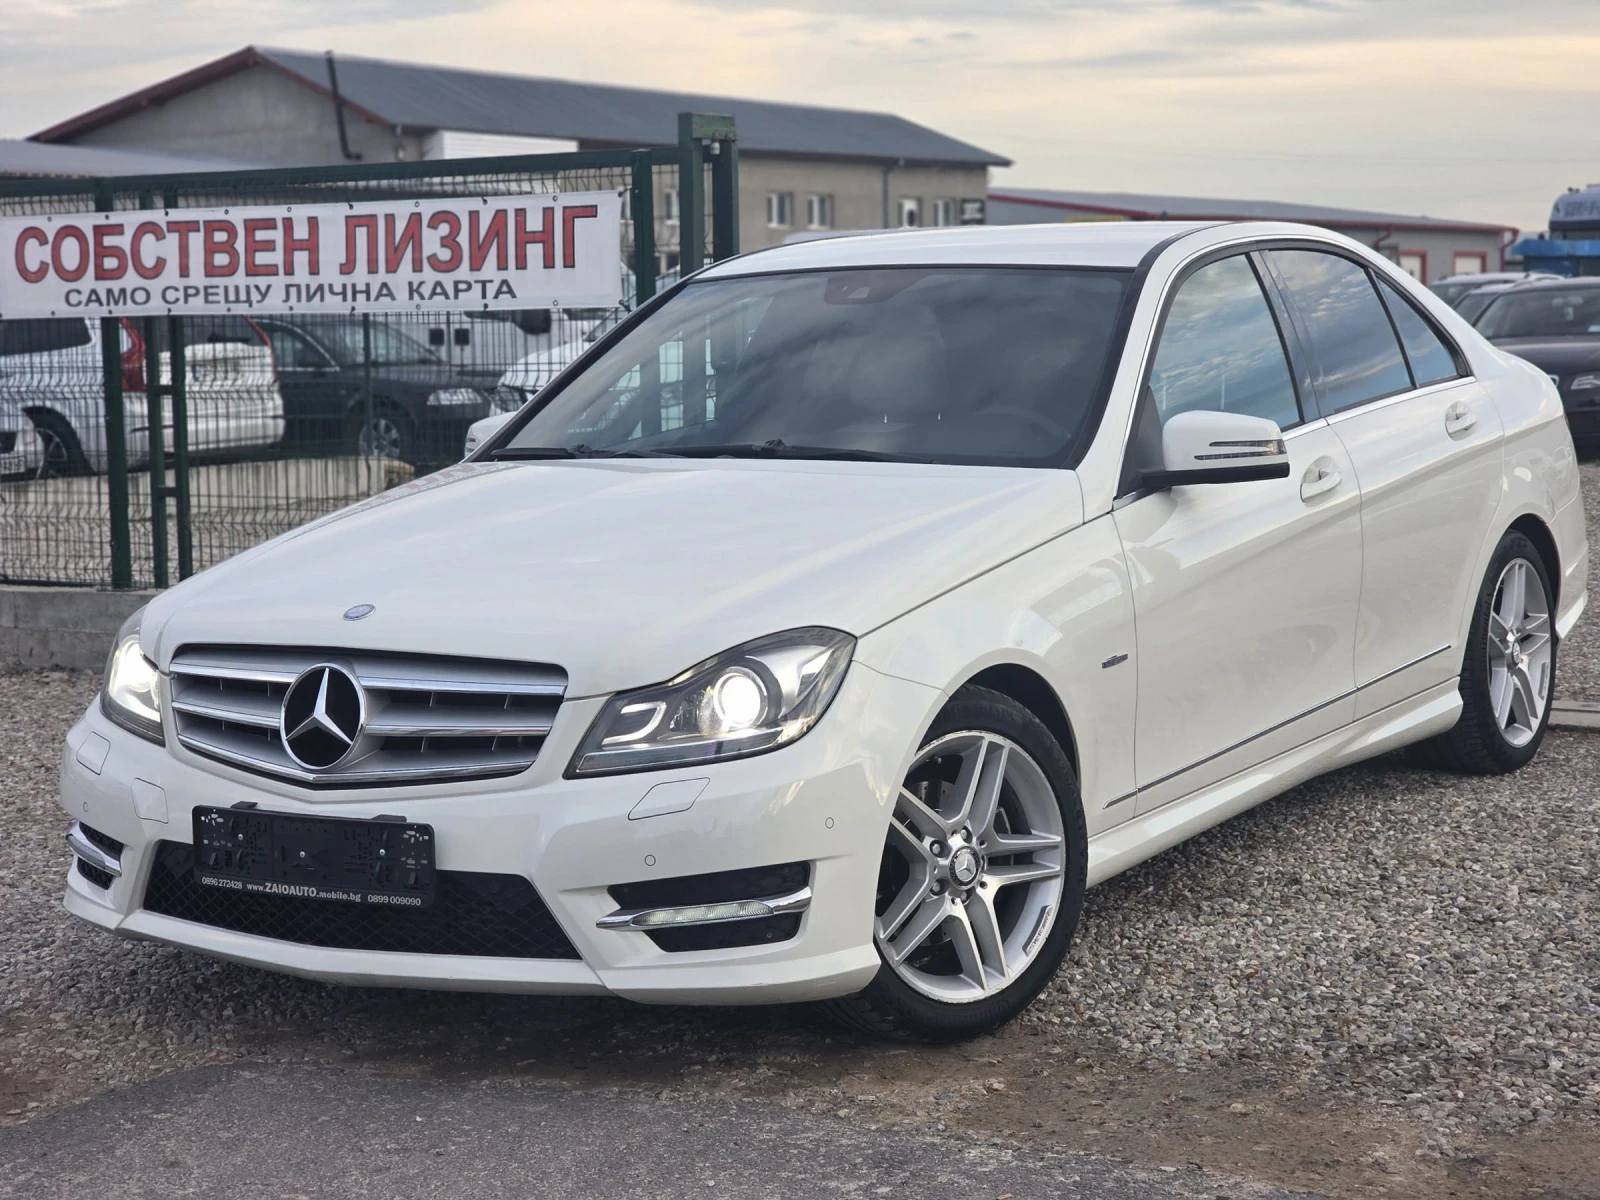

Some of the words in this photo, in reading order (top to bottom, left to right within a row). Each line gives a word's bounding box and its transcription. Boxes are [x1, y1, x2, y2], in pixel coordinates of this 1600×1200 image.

[15, 216, 320, 283] СОБСТВЕН
[339, 204, 598, 275] ЛИЗИНГ
[64, 286, 151, 307] САМО
[161, 284, 272, 308] СРЕЩУ
[282, 283, 396, 303] ЛИЧНА
[408, 279, 517, 300] КАРТА
[246, 882, 361, 903] www.ZAIOAUTO.mobile.bg
[367, 894, 389, 904] 0899
[390, 895, 422, 906] 009090
